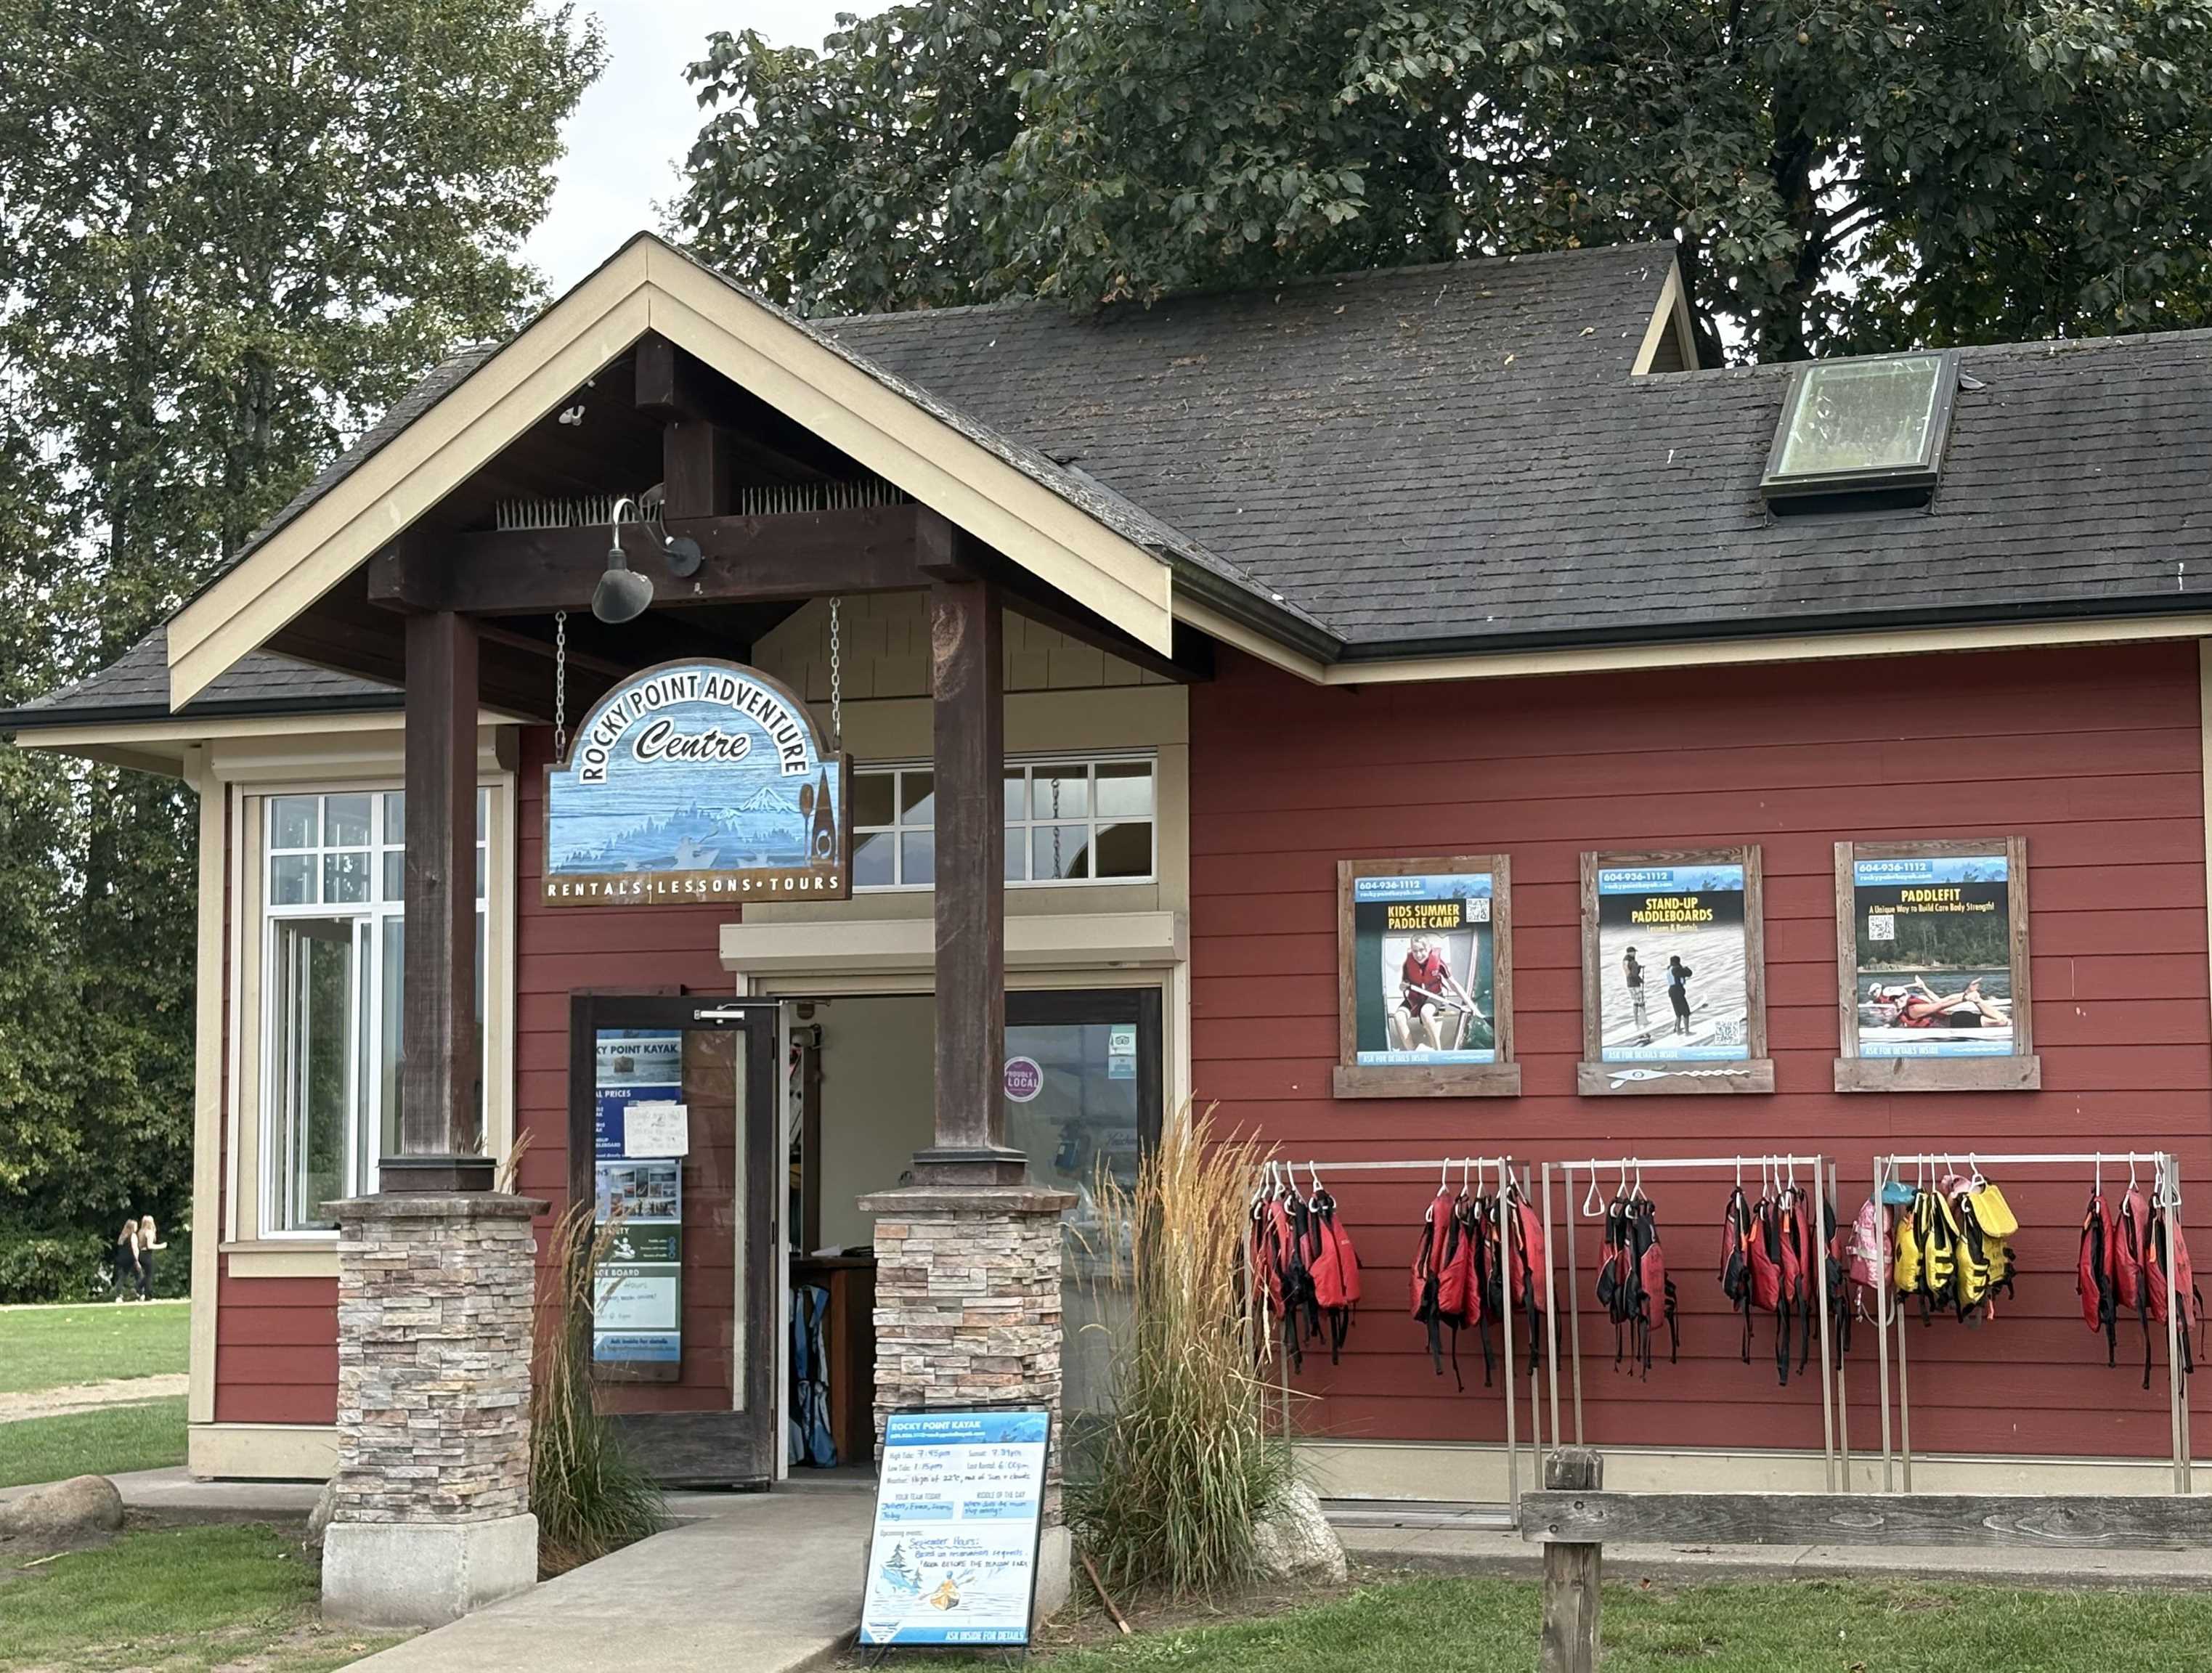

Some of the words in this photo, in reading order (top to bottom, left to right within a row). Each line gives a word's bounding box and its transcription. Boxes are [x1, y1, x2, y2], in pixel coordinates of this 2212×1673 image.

[582, 704, 630, 781] ROCKY
[630, 676, 698, 715] POINT
[704, 676, 807, 773] ADVENTURE
[636, 720, 748, 759] Centre
[1859, 863, 1927, 872] 604-936-1112
[1603, 872, 1668, 882] 604-936-1112
[548, 882, 641, 897] RENTALS
[658, 879, 751, 894] LESSONS
[770, 876, 839, 891] TOURS
[1359, 880, 1420, 890] 604-936-1112
[1901, 888, 1961, 903] PADDLEFIT
[1646, 897, 1699, 911] STAND-UP
[1869, 905, 1874, 914] A
[1388, 905, 1412, 918] KIDS
[1415, 904, 1460, 916] SUMMER
[1631, 908, 1713, 924] PADDLEBOARDS
[1388, 917, 1427, 929] PADDLE
[1428, 916, 1460, 928] CAMP
[611, 1045, 641, 1054] POINT
[644, 1044, 678, 1054] KAYAK
[1008, 1078, 1038, 1087] LOCAL
[891, 1422, 921, 1431] ROCKY
[922, 1421, 951, 1430] POINT
[951, 1420, 982, 1429] KAYAK
